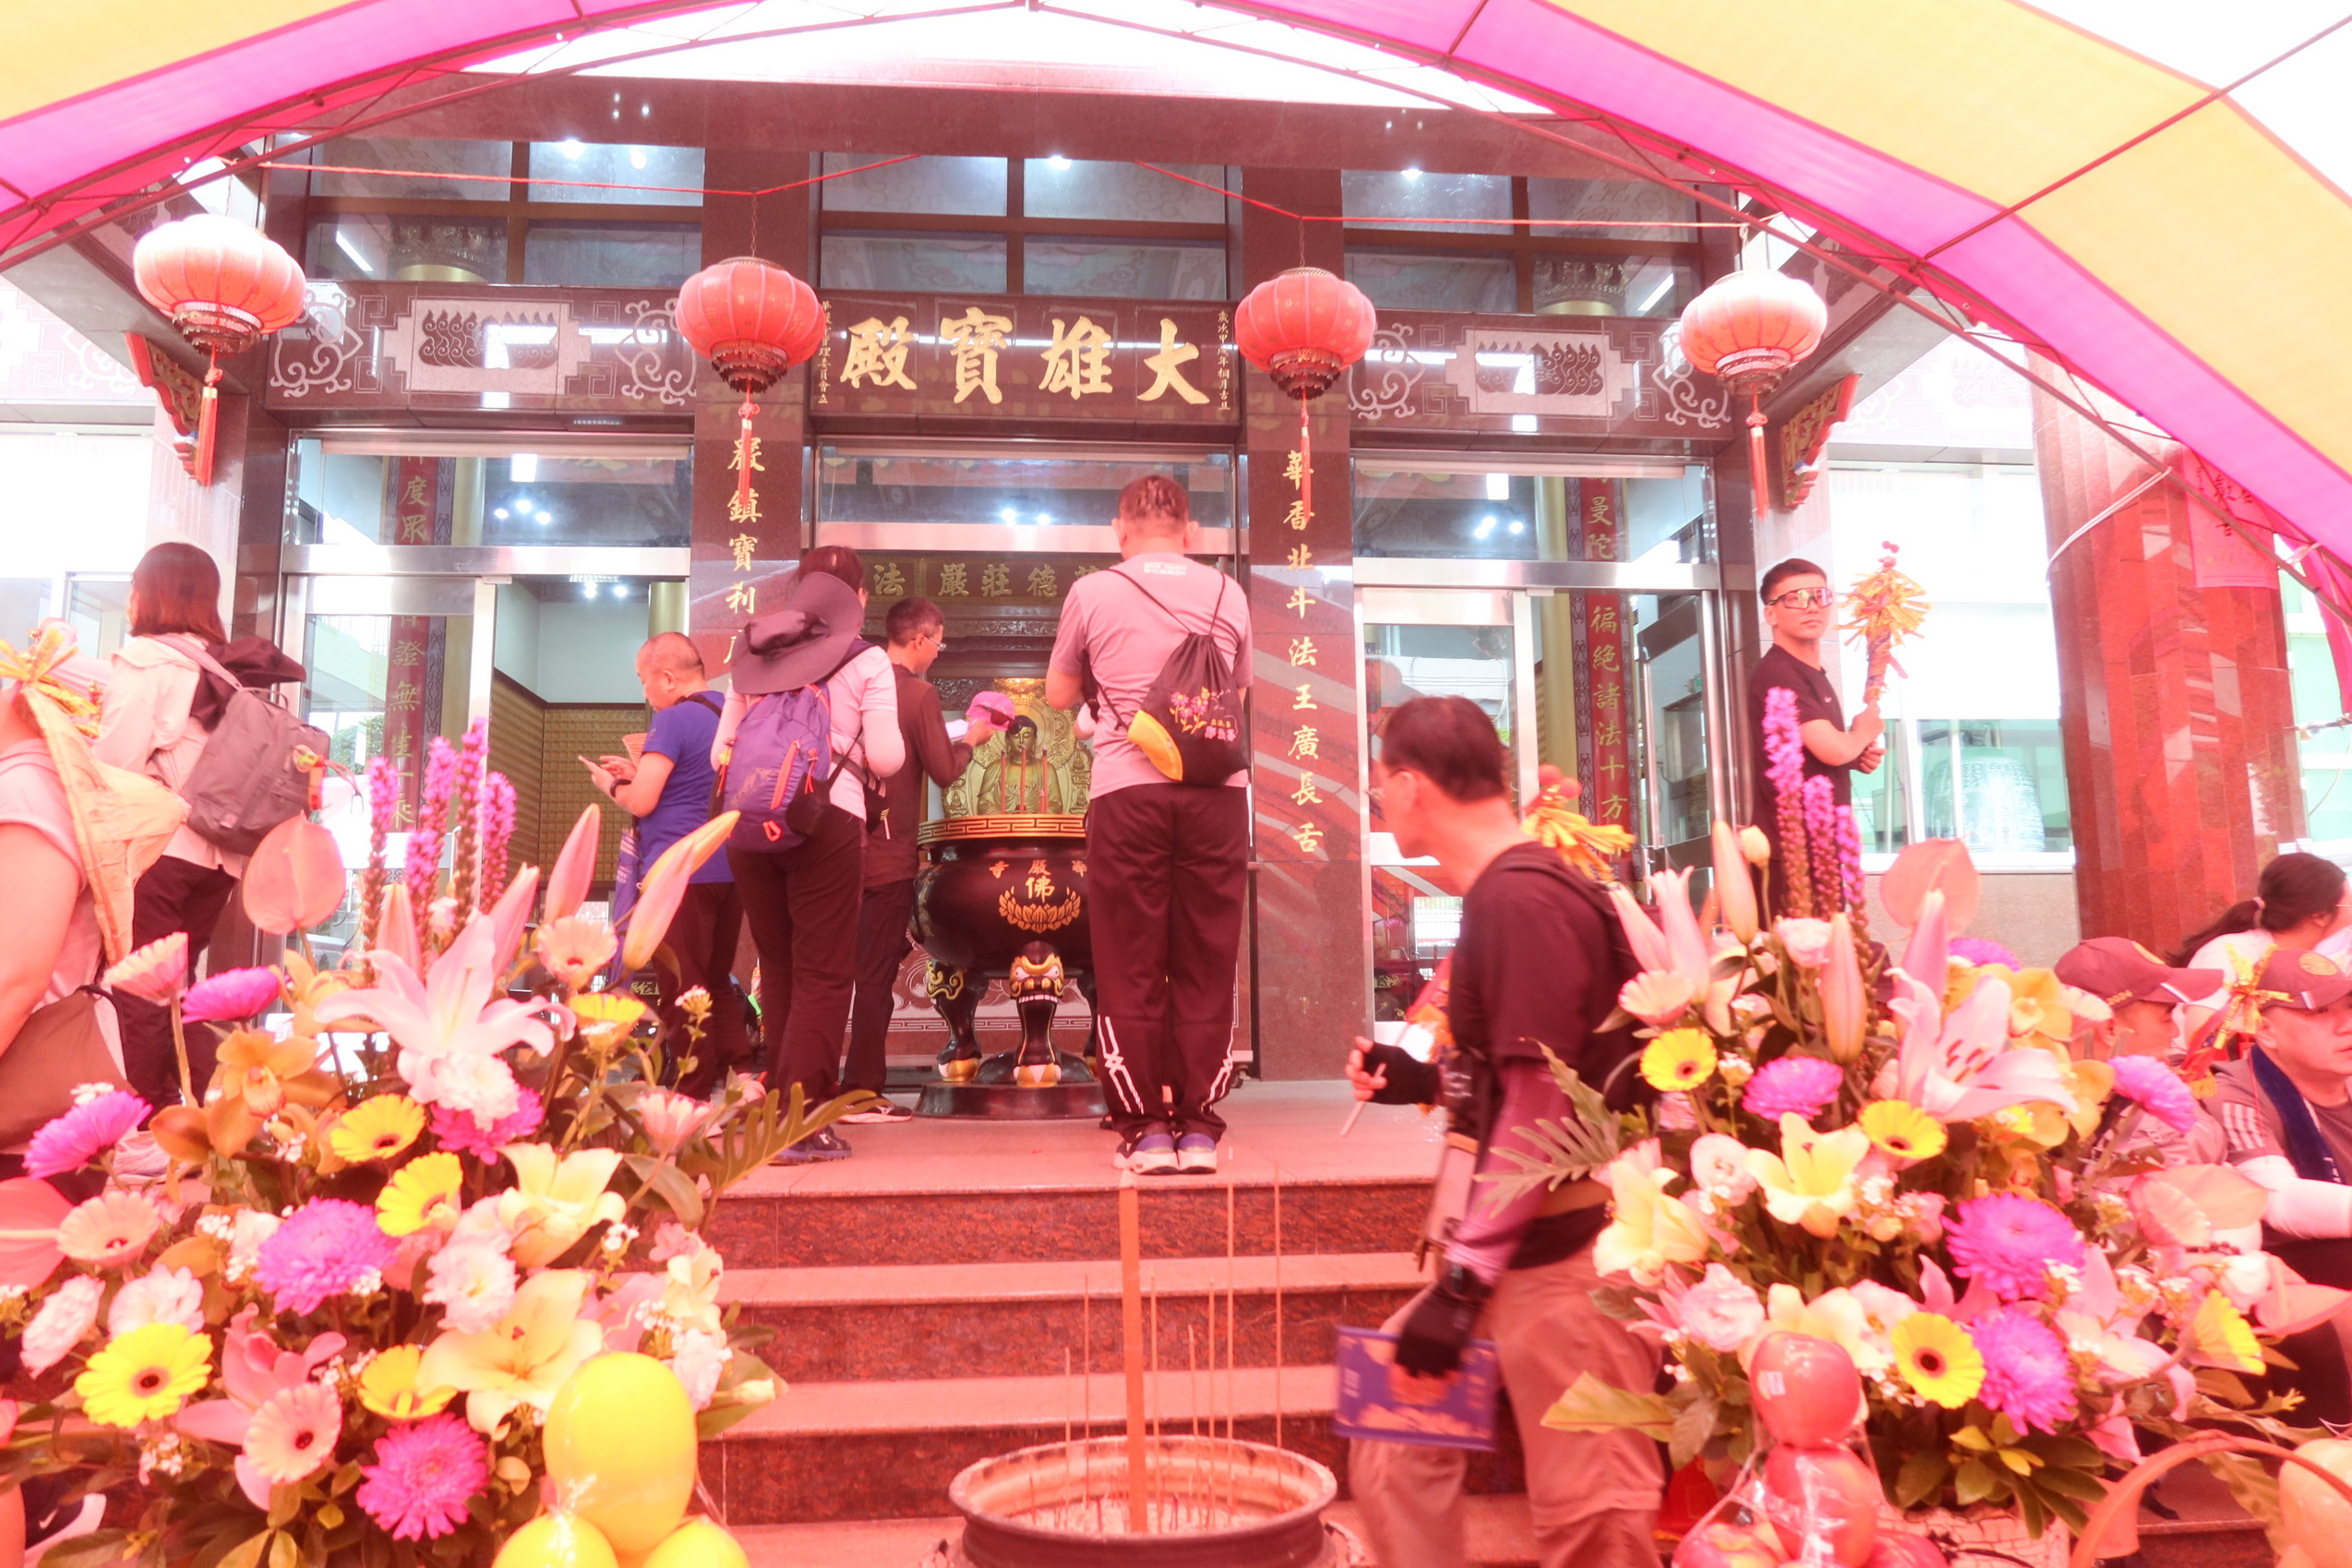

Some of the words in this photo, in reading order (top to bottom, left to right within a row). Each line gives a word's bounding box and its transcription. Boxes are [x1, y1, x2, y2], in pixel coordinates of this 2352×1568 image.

[840, 306, 1210, 405] 大雄寶殿
[1026, 877, 1056, 904] 佛
